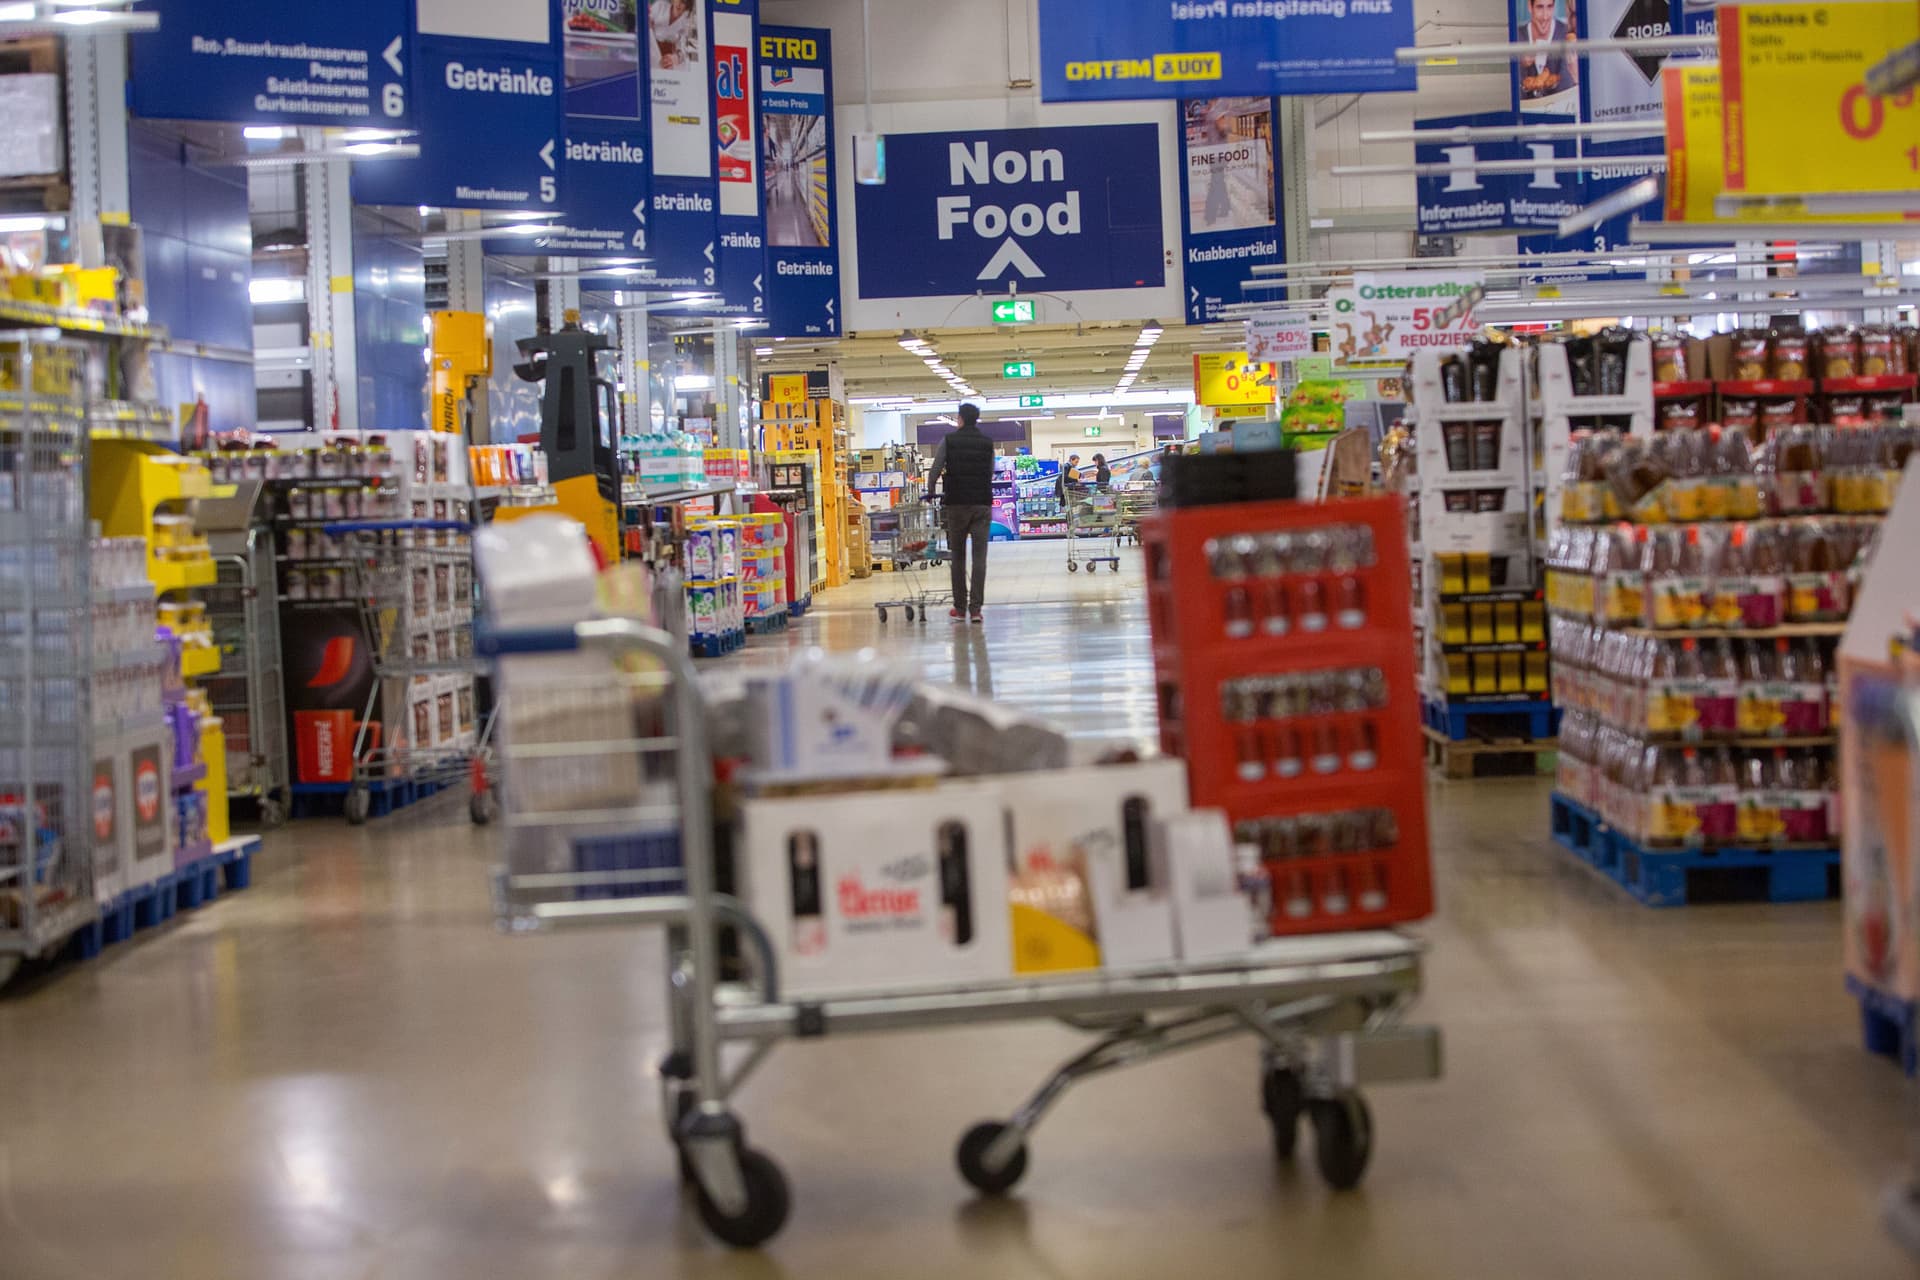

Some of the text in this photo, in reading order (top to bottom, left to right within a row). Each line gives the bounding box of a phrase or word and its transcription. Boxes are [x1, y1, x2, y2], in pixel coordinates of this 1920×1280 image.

[1627, 22, 1672, 38] RIOBA
[445, 62, 553, 96] Getränke
[382, 83, 404, 117] 6
[1594, 107, 1632, 118] UNSERE
[949, 141, 1064, 185] Non
[1191, 149, 1249, 166] FINE FOOD
[540, 176, 556, 203] 5
[937, 190, 1081, 240] Food
[1420, 202, 1505, 222] Information
[632, 229, 646, 250] 4
[1593, 236, 1606, 253] 3
[1189, 240, 1278, 263] Knabberartikel
[703, 267, 715, 286] 3
[777, 260, 833, 276] Getränke
[1359, 282, 1478, 300] Osterartike
[753, 297, 763, 313] 2
[1192, 305, 1199, 320] 1
[827, 318, 835, 332] 1
[1226, 375, 1240, 391] 0
